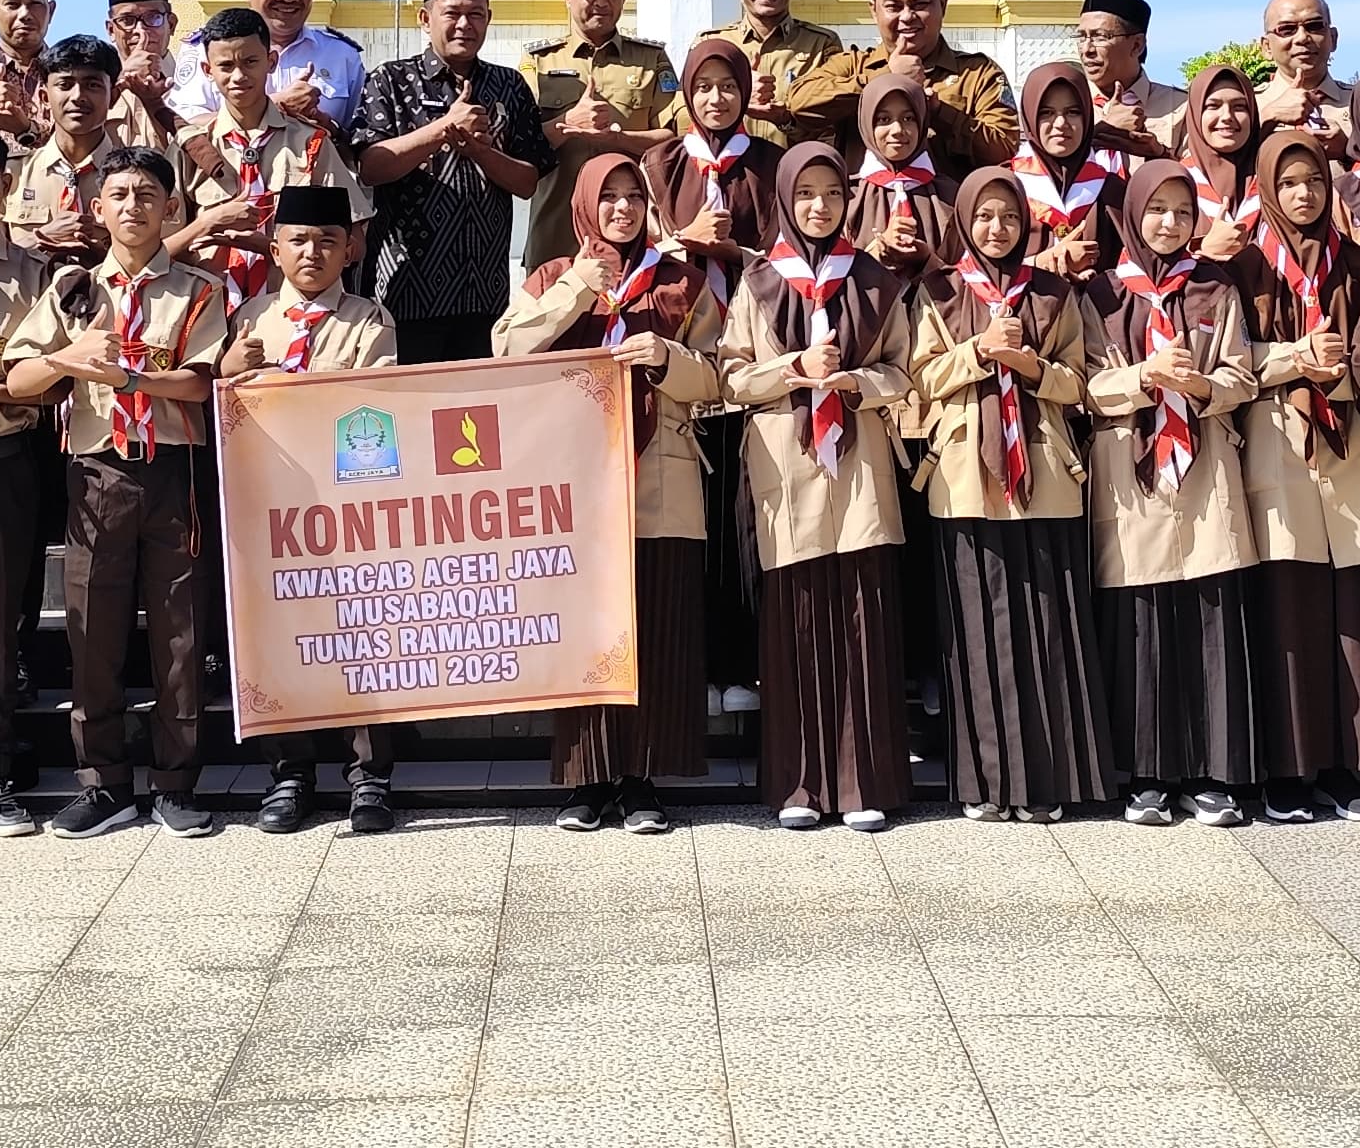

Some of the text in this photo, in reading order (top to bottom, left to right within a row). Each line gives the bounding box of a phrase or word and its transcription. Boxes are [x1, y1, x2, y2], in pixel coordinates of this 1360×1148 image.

[269, 483, 574, 558] KONTINGEN
[273, 545, 576, 600] KWARCAB ACEH JAYA
[337, 584, 517, 629] MUSABAQAH
[296, 613, 560, 665] TUNAS RAMADHAN
[343, 652, 519, 695] TAHUN 2025
